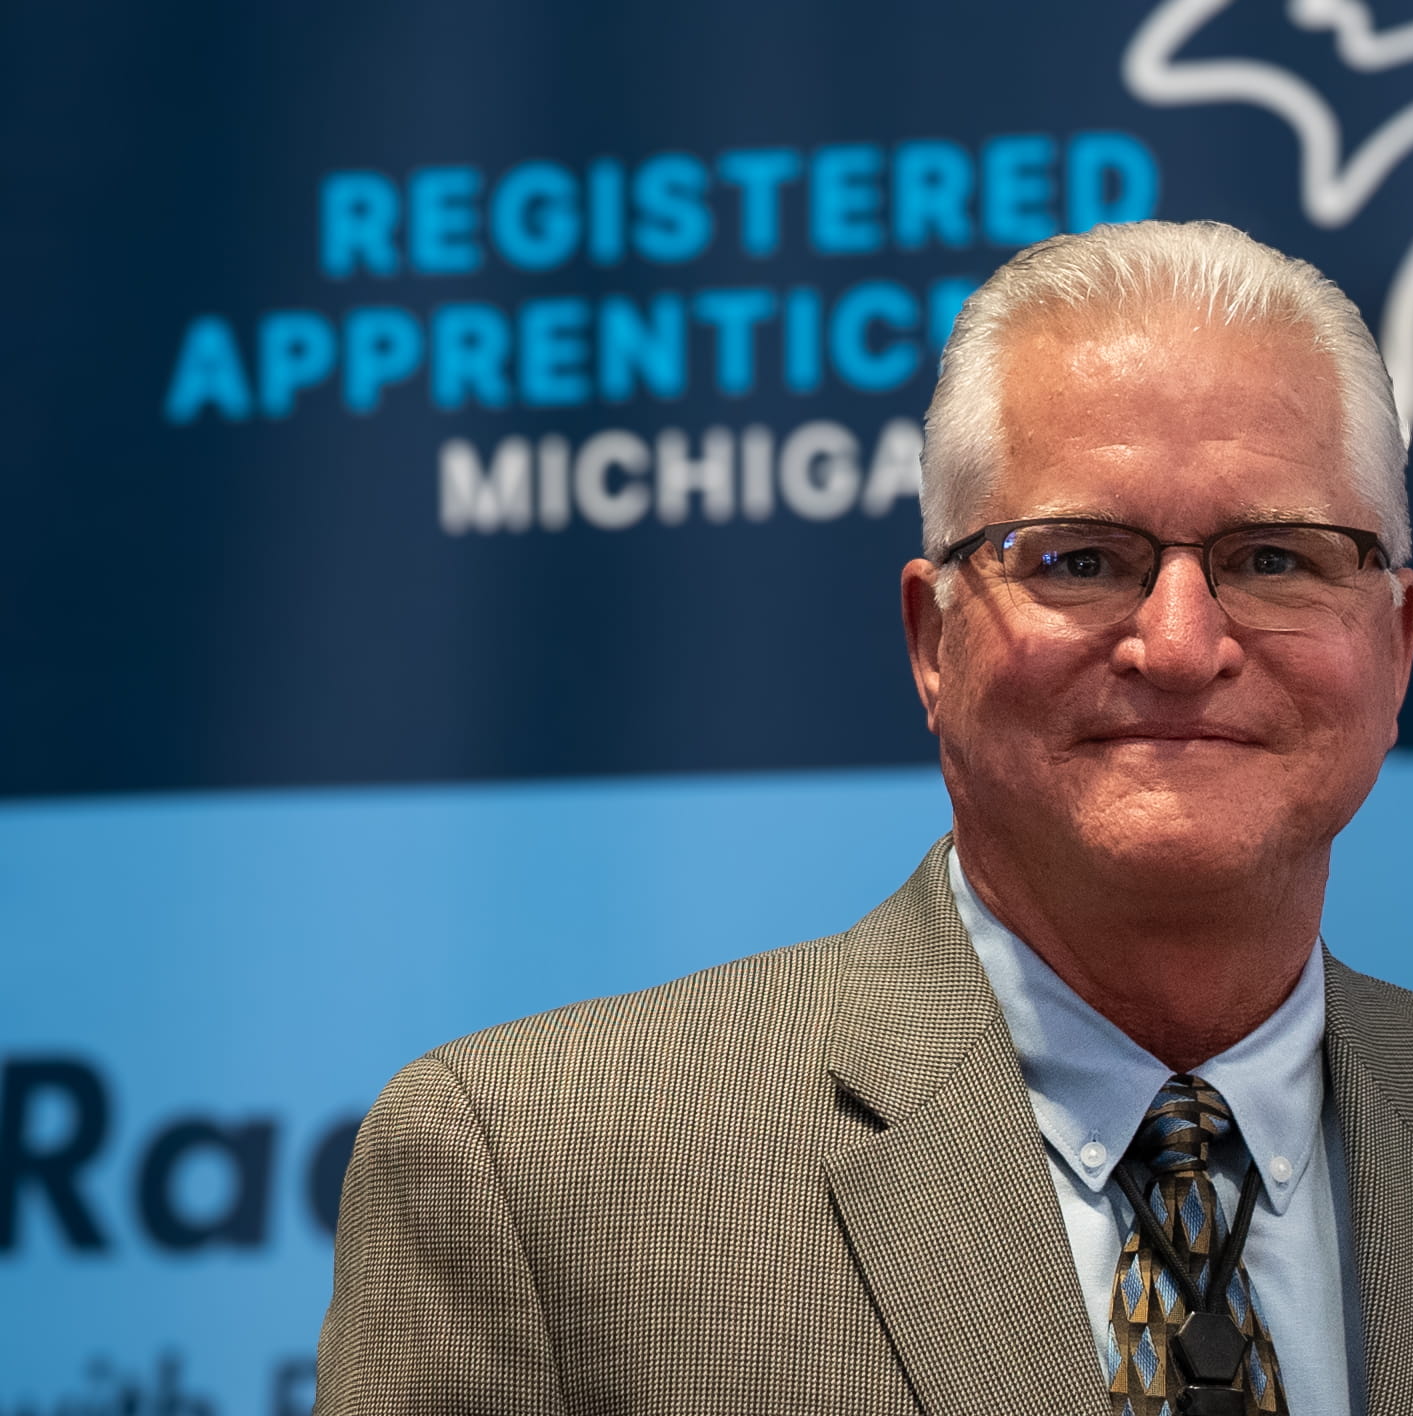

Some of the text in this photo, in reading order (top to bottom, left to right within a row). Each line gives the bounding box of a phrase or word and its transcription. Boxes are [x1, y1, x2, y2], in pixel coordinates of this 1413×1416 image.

[319, 130, 1160, 279] REGISTERED
[164, 274, 978, 424] APPRENTIC
[440, 421, 924, 535] MICHIGA
